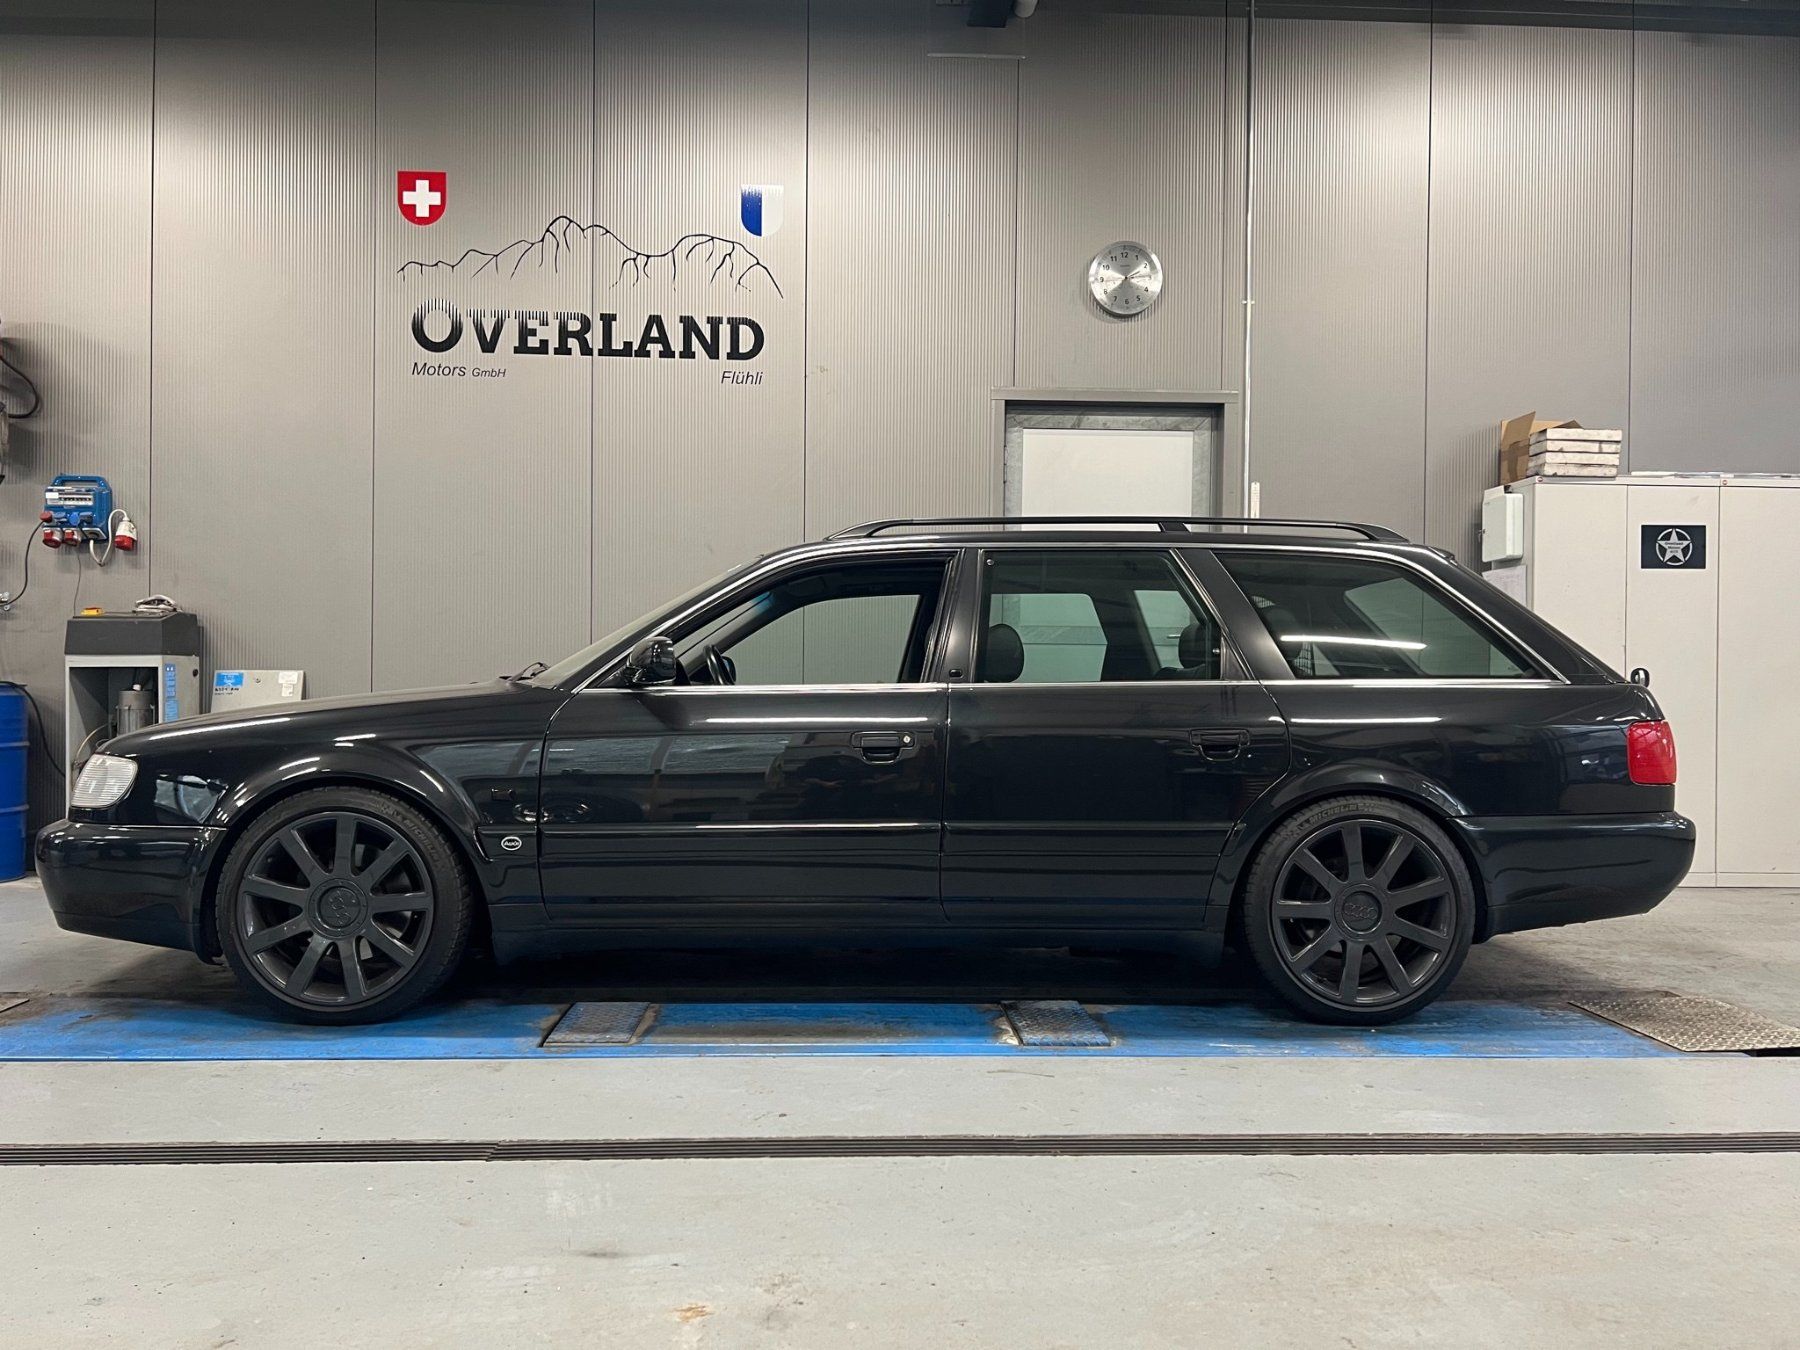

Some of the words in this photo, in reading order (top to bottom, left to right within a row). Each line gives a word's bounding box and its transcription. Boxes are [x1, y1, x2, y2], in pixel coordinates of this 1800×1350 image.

[411, 298, 765, 360] OVERLAND
[412, 362, 467, 377] Motors
[471, 367, 506, 377] GmbH
[721, 370, 763, 385] Flühli
